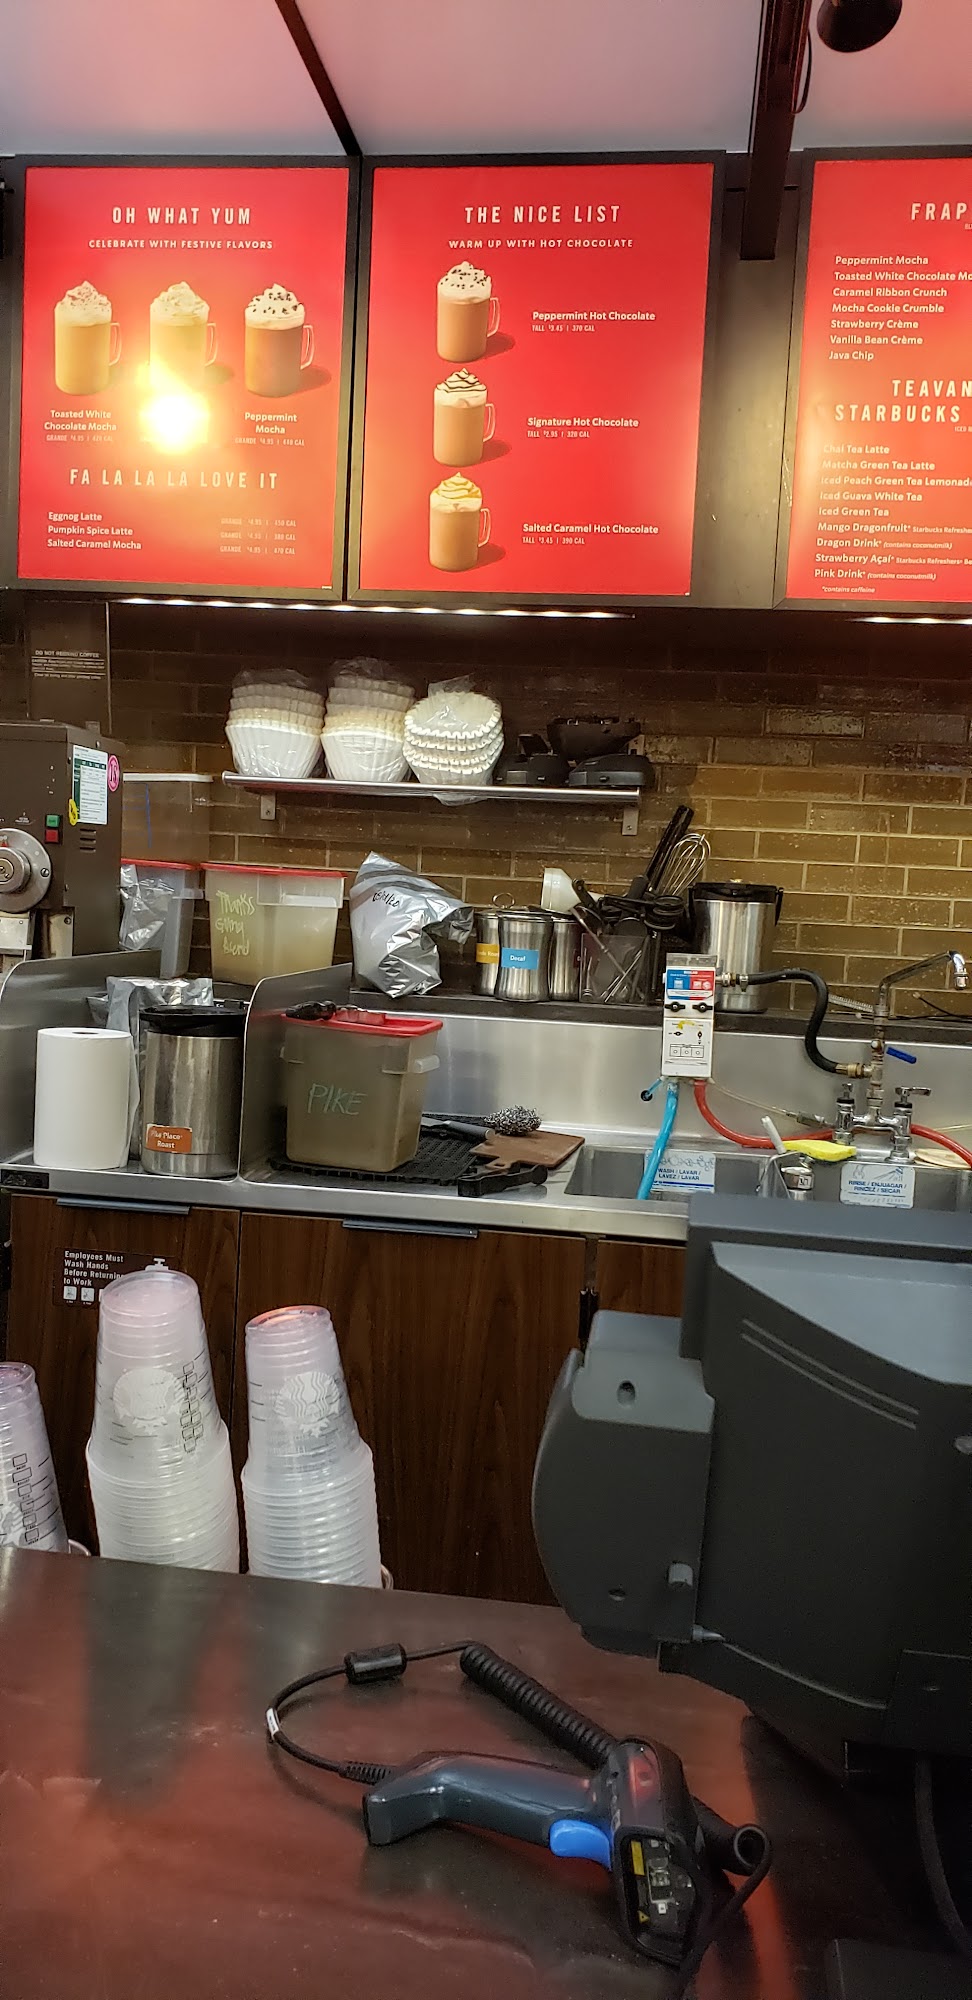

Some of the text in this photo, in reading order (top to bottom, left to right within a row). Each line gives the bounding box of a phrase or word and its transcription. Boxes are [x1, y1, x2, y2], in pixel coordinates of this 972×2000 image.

[112, 207, 250, 224] OH WHAT YUM
[465, 205, 620, 223] THE NICE LIST
[911, 203, 967, 220] FRAP
[88, 240, 273, 249] CELEBRATE WITH FESTIVE FLAVORS
[449, 239, 633, 248] WARM UP WITH HOT CHOCOLATE
[835, 256, 929, 266] Peppermint Mocha
[834, 272, 872, 280] Toasted
[874, 272, 904, 280] White
[906, 272, 956, 280] Chocolate
[833, 288, 947, 296] Caramel Ribbon Crunch
[832, 304, 944, 313] Mocha Cookie Crumble
[532, 311, 656, 322] Peppermint Hot Chocolate
[831, 319, 919, 330] Strawberry Crème
[830, 335, 923, 344] Vanilla Bean Crème
[829, 351, 874, 361] Java Chip
[892, 380, 972, 397] TEAVAN
[50, 410, 112, 418] Toasted White
[245, 412, 297, 422] Peppermint
[835, 404, 960, 422] STARBUCKS
[44, 422, 117, 430] Chocolate Mocha
[527, 417, 639, 428] Signature Hot Chocolate
[256, 425, 286, 434] Mocha
[527, 430, 540, 438] TALL
[823, 445, 890, 454] Chai Tea Latte
[822, 460, 935, 470] Matcha Green Tea Latte
[69, 468, 278, 489] FA LA LA LA LOVE IT
[821, 476, 841, 485] Iced
[844, 476, 872, 485] Peach
[874, 476, 904, 485] Green
[906, 477, 922, 485] Tea
[820, 491, 923, 501] Iced Guava White Tea
[819, 507, 889, 516] Iced Green Tea
[48, 512, 102, 522] Eggnog Latte
[48, 526, 133, 536] Pumpkin Spice Latte
[523, 523, 659, 534] Salted Caramel Hot Chocolate
[818, 522, 850, 533] Mango
[47, 539, 142, 550] Salted Caramel Mocha
[816, 538, 850, 548] Dragon
[815, 554, 868, 565] Strawberry
[814, 569, 835, 578] Pink
[306, 1082, 368, 1116] PIKE
[64, 1250, 123, 1262] Employees Must
[64, 1259, 108, 1270] Wash Hands
[64, 1268, 88, 1277] Before
[73, 1278, 92, 1286] Work
